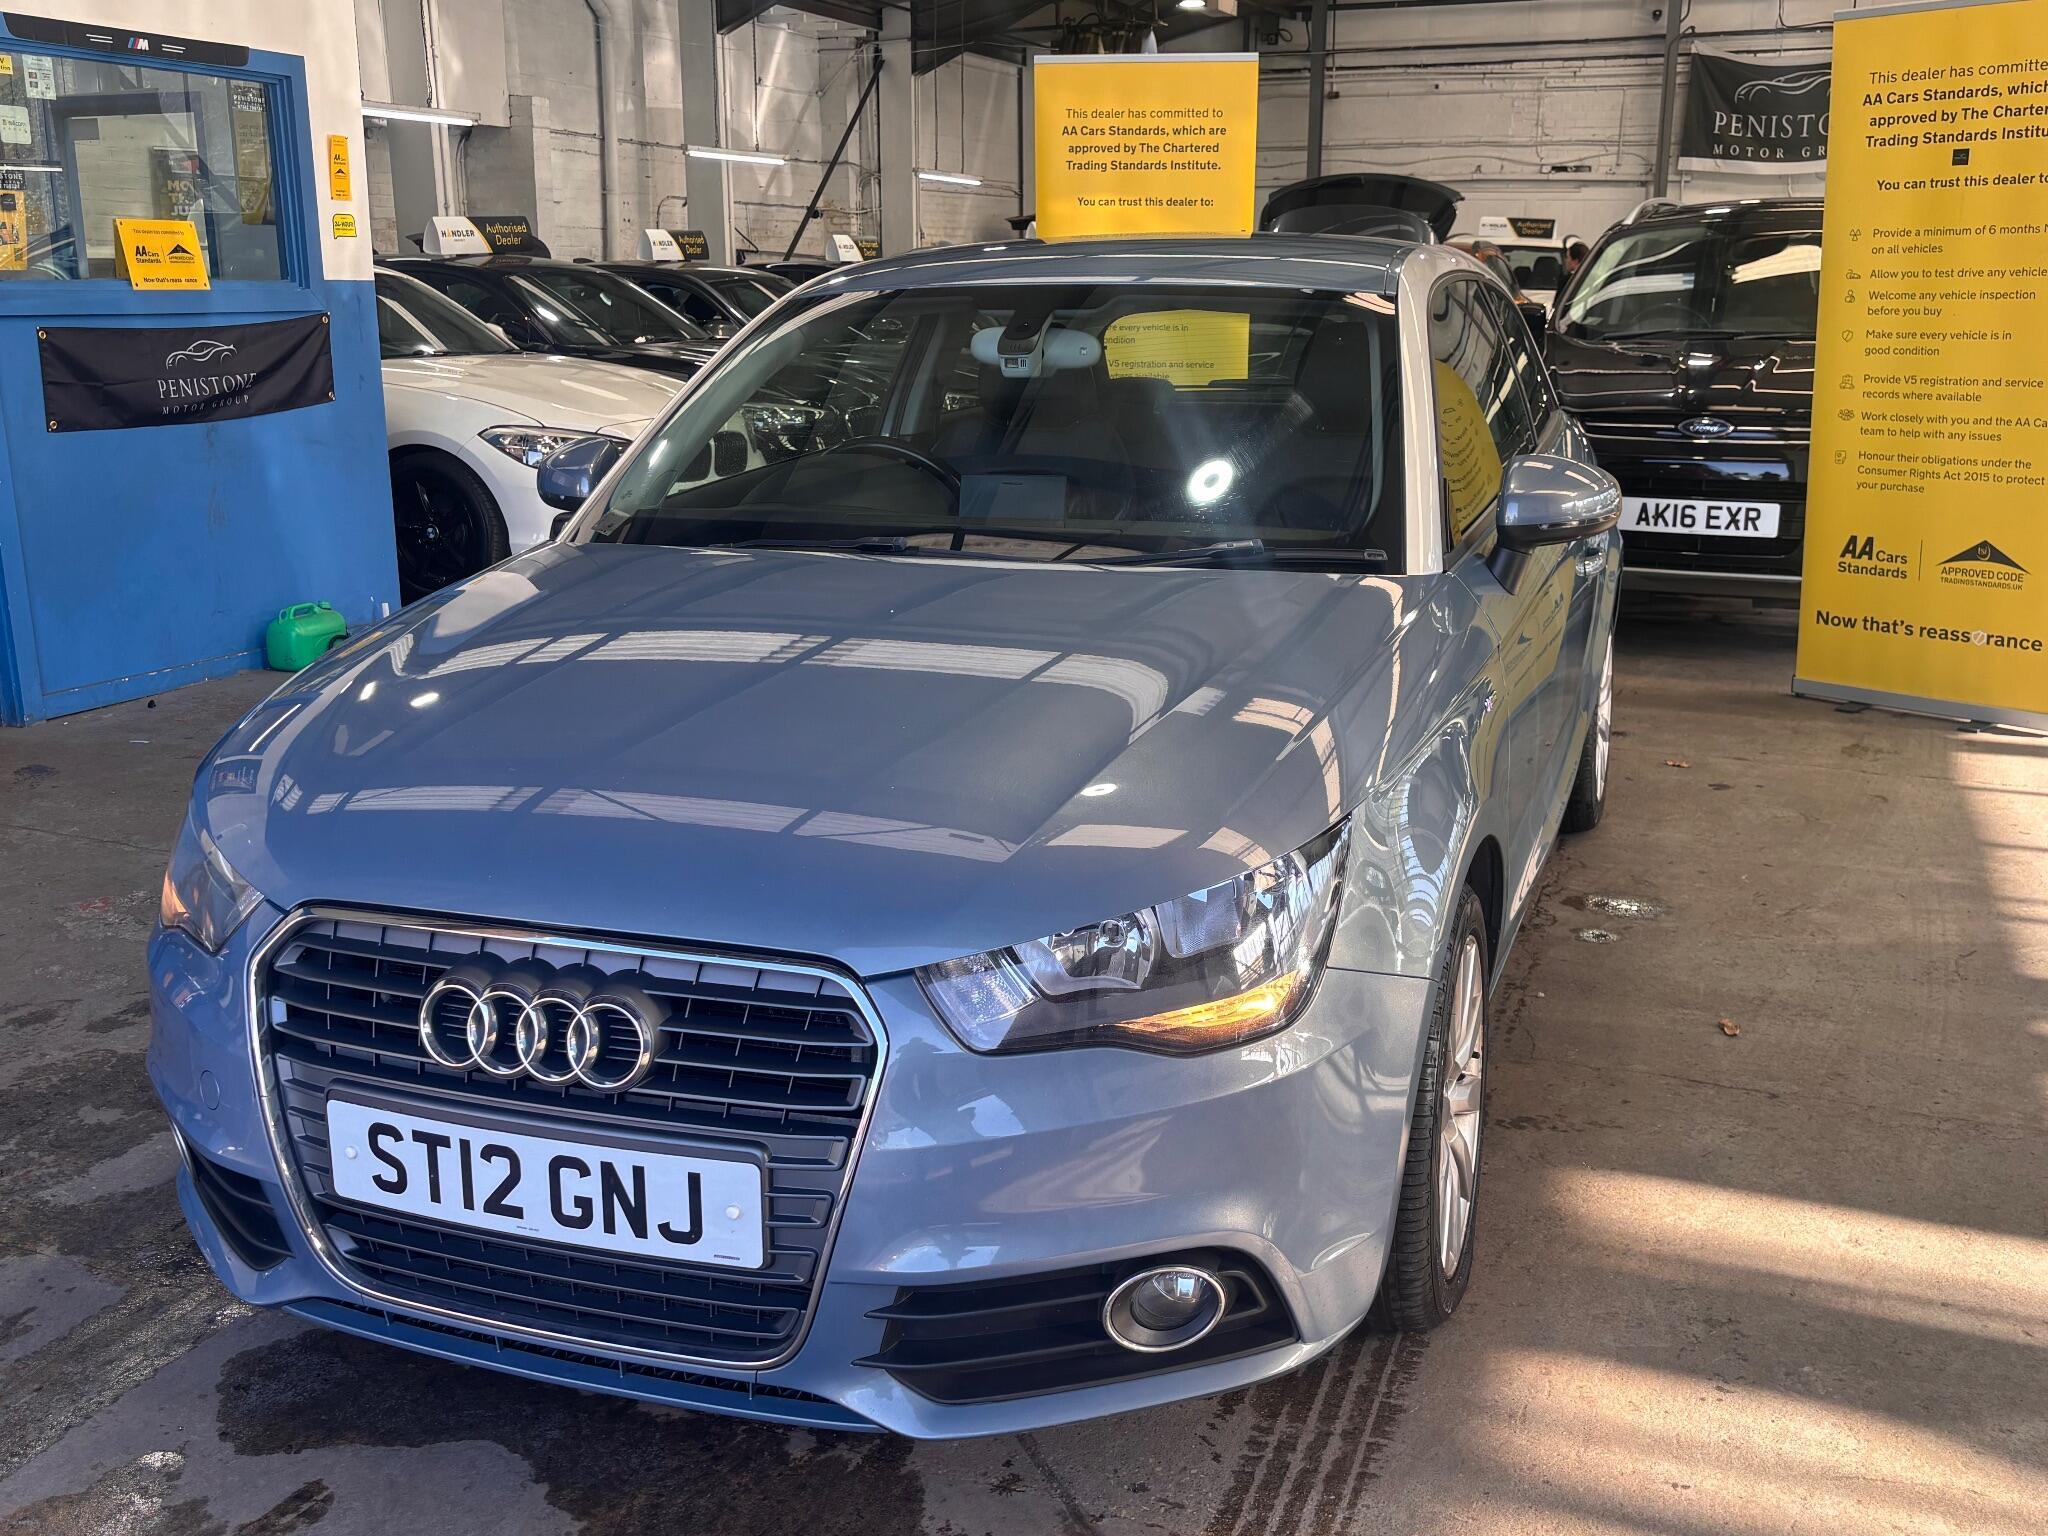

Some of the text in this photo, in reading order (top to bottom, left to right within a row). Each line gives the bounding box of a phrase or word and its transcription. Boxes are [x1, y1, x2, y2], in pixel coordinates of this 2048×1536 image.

[1869, 58, 2048, 85] This dealer has committe
[1862, 79, 2048, 107] AA Cars Standards, which
[1066, 107, 1223, 119] This dealer has committed to
[1869, 103, 2048, 128] approved by The Charter
[1062, 125, 1227, 138] AA Cars Standards, which are
[1712, 110, 1829, 139] PENISTO
[1865, 124, 2048, 150] Trading Standards Institu
[1068, 143, 1219, 155] approved by The Chartered
[1712, 143, 1826, 159] MOTOR GR
[1066, 160, 1221, 173] Trading Standards Institute.
[1877, 173, 2035, 192] You can trust this dealer
[1077, 197, 1214, 207] You can trust this dealer to:
[486, 222, 527, 234] Authorised
[1873, 227, 1912, 239] Provide
[1923, 226, 1972, 237] minimum
[1975, 224, 1986, 235] of
[1988, 224, 1997, 235] 6
[1999, 224, 2041, 235] months
[495, 235, 522, 245] Dealer
[135, 245, 147, 257] AA
[1871, 243, 1943, 255] on all vehicles
[1870, 266, 2047, 281] Allow you to test drive any vehicle
[1868, 289, 2036, 302] Welcome any vehicle inspection
[1867, 306, 1942, 318] before you buy
[1119, 324, 1140, 333] every
[1142, 323, 1170, 331] vehicle
[1181, 323, 1189, 331] in
[1866, 329, 2012, 342] Make sure every vehicle is in
[1104, 336, 1136, 344] ondition
[1864, 346, 1940, 357] good condition
[1109, 359, 1215, 369] V5 registration and service
[157, 372, 257, 399] PENISTONE
[1863, 374, 2044, 388] Provide V5 registration and service
[1862, 390, 1982, 402] records where available
[162, 394, 249, 415] MOTOR GROUP
[1861, 411, 2048, 428] Work closely with you and the AA Ca
[1860, 426, 2002, 442] team to help with any issues
[1858, 451, 2032, 469] Honour their obligations under the
[1857, 465, 2045, 486] Consumer Rights Act 2015 to protect
[1856, 481, 1925, 493] your purchase
[1636, 502, 1761, 532] AK16 EXR
[1839, 535, 1908, 565] AA Cars
[1837, 562, 1908, 580] Standards
[1940, 566, 2025, 583] APPROVED CODE
[1940, 577, 2024, 591] TRADINGSTANDARDS.UK
[1816, 610, 1857, 628] Now
[367, 1121, 704, 1245] ST12 GNJ
